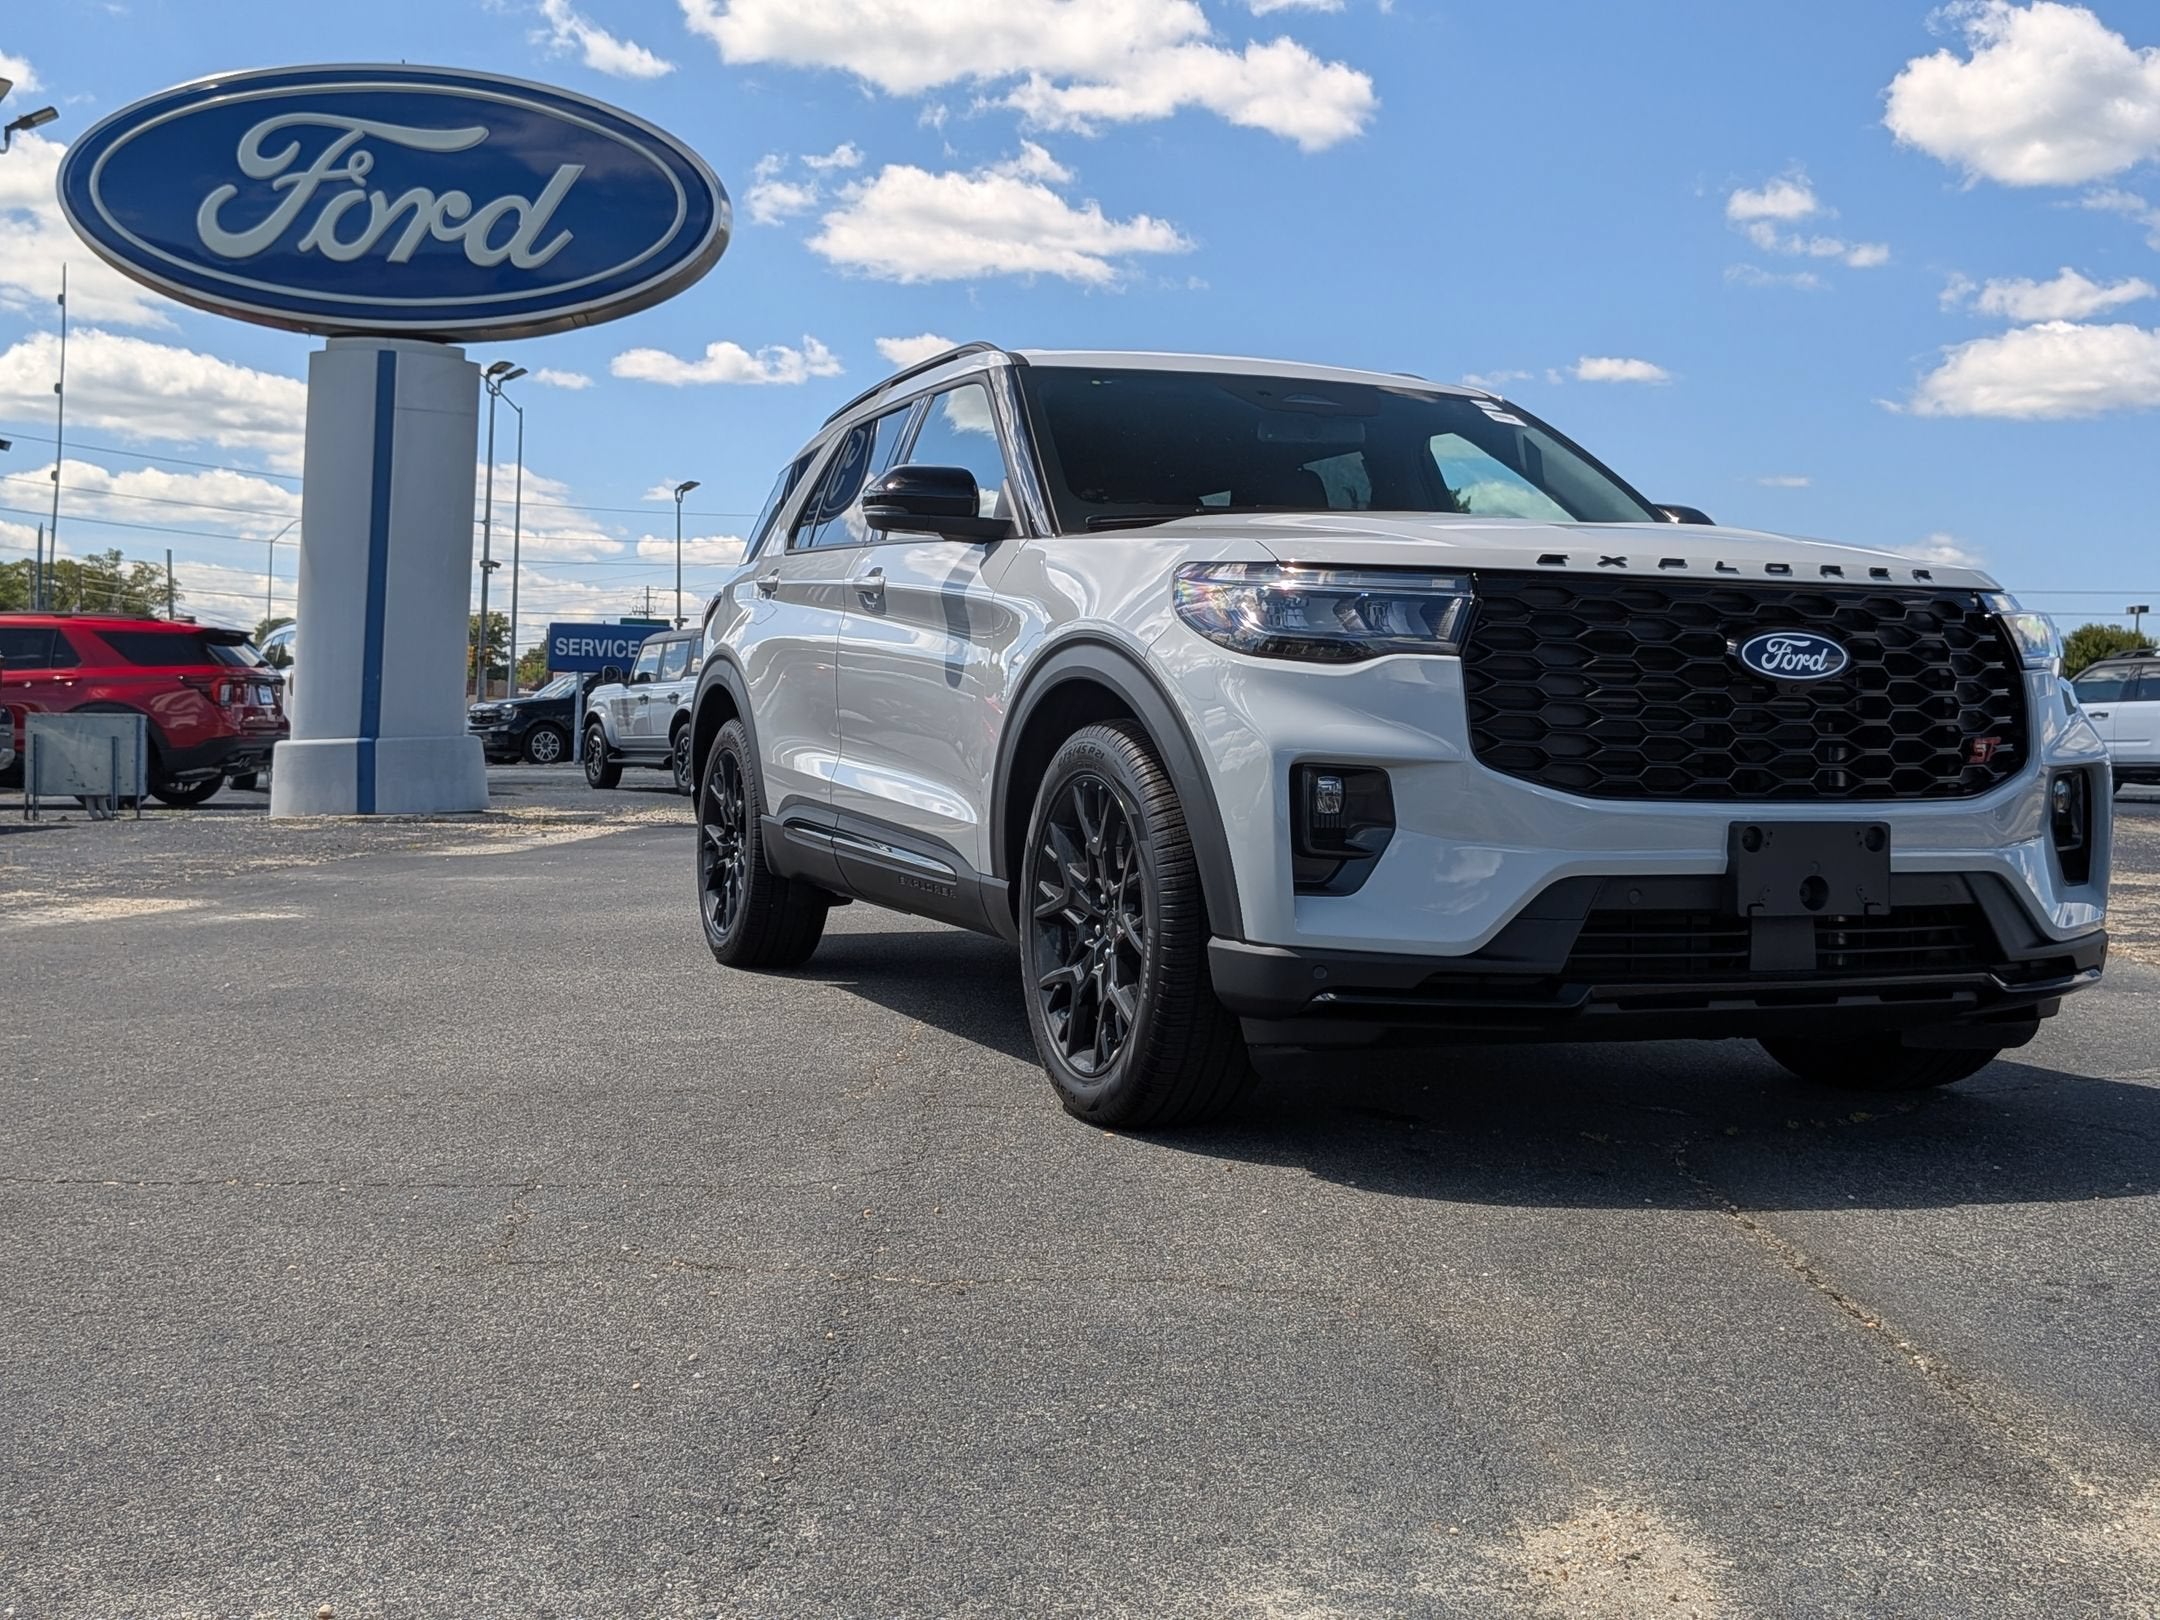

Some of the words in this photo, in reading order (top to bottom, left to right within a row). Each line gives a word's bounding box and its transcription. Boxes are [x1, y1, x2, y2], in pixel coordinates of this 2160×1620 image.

[197, 111, 586, 269] Ford
[1536, 553, 1933, 583] EXPLORER
[555, 637, 640, 658] SERVICE
[1761, 638, 1829, 671] Ford
